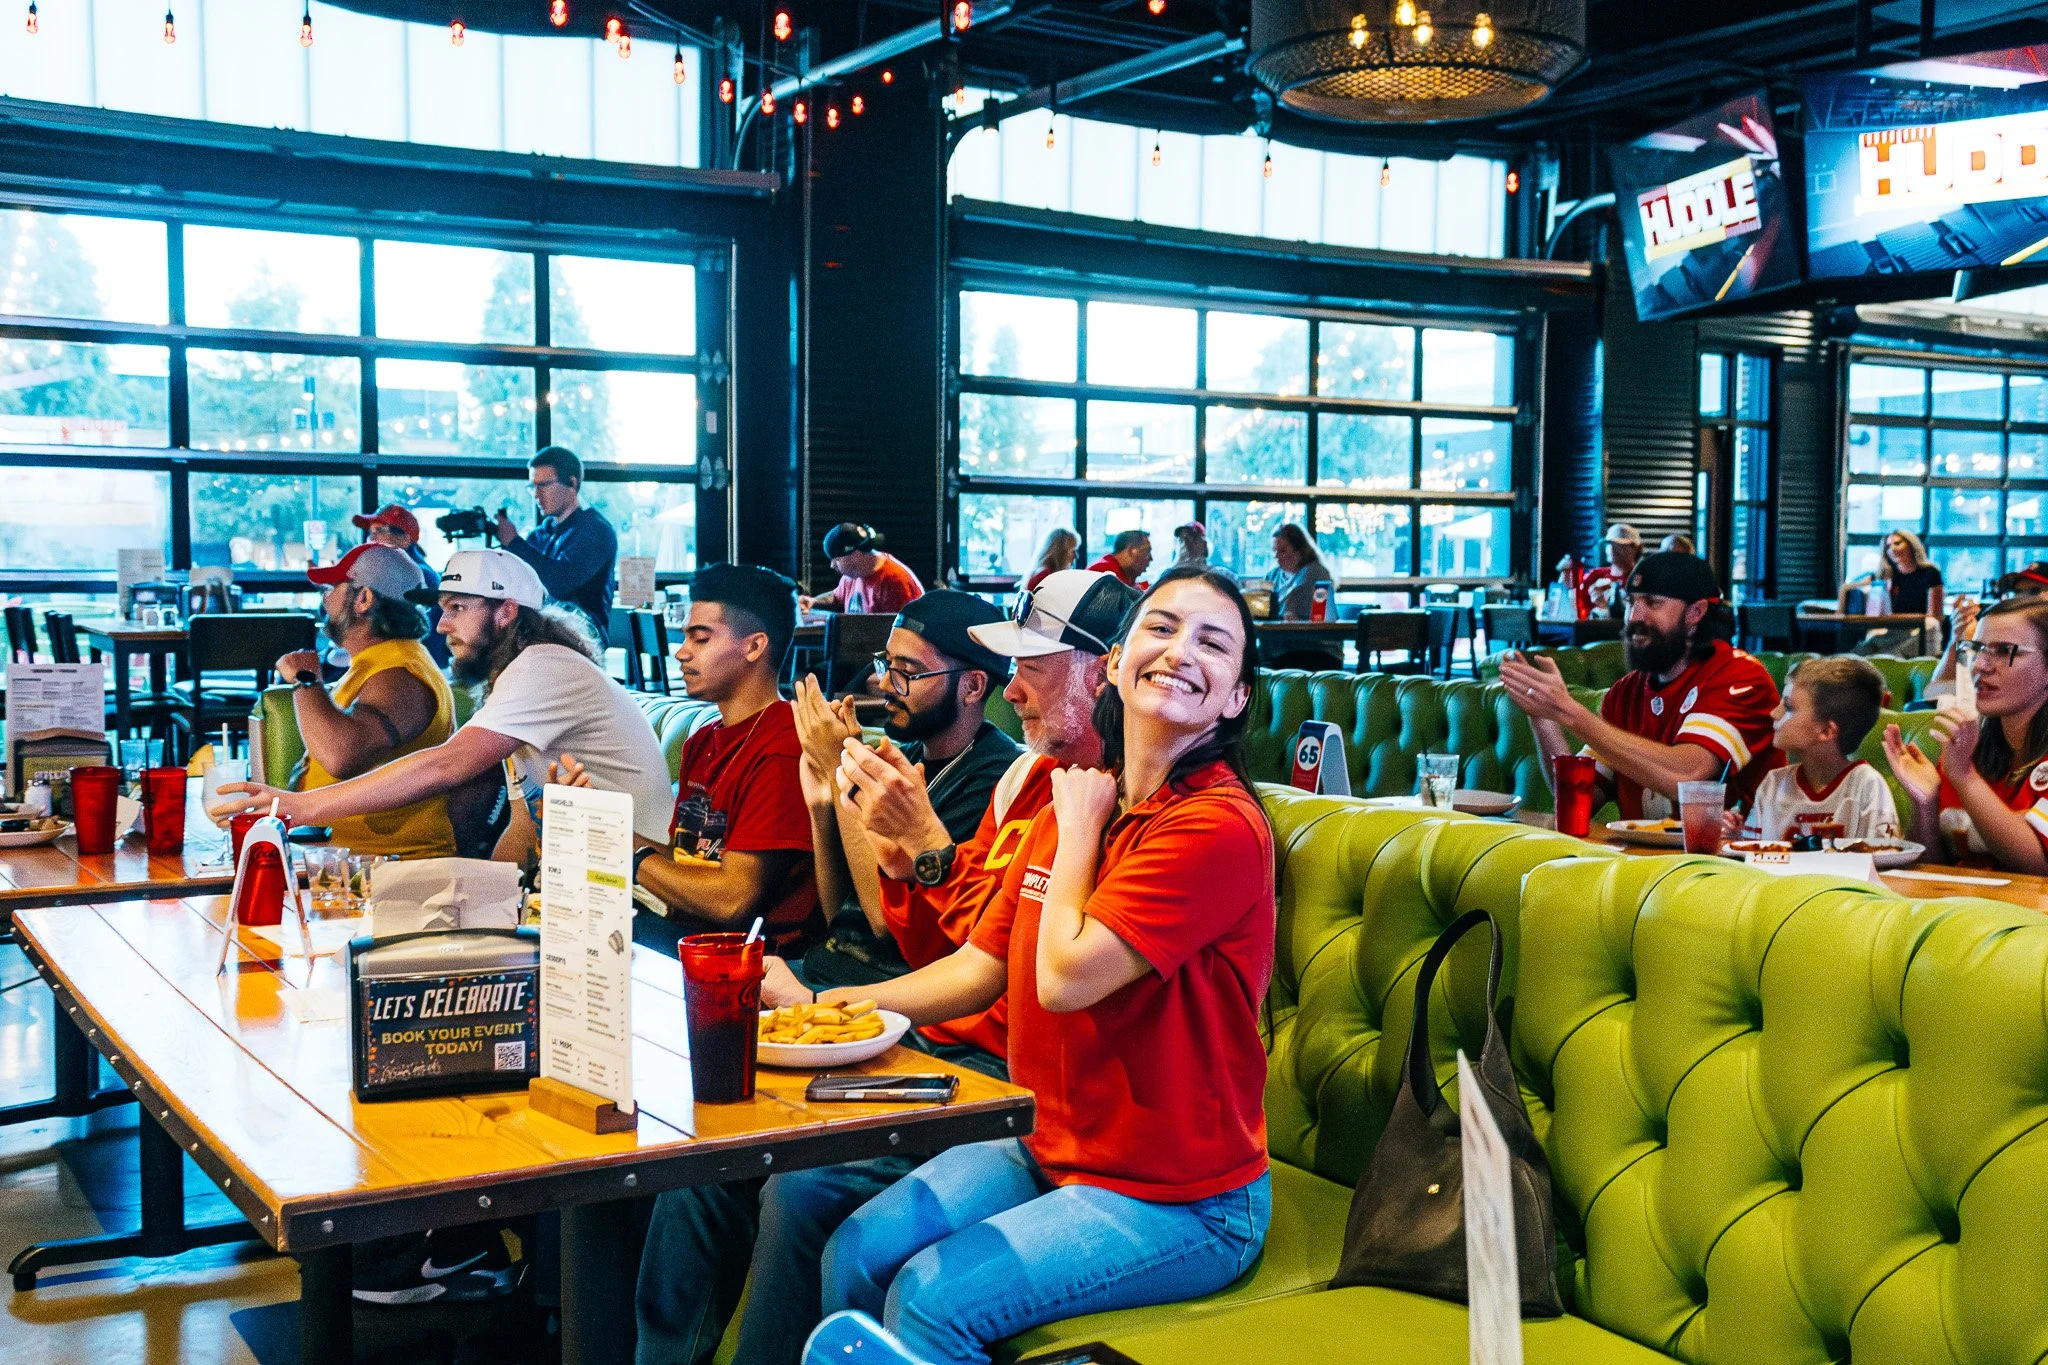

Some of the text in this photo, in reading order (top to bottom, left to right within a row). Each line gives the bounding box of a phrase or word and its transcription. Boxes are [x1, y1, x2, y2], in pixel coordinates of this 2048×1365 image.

[1640, 171, 1757, 246] HUDDLE
[1299, 744, 1319, 764] 65
[373, 994, 416, 1021] LET'S
[419, 981, 528, 1019] CELEBRATE
[381, 1022, 525, 1044] BOOK YOUR EVENT
[425, 1040, 483, 1055] TODAY!
